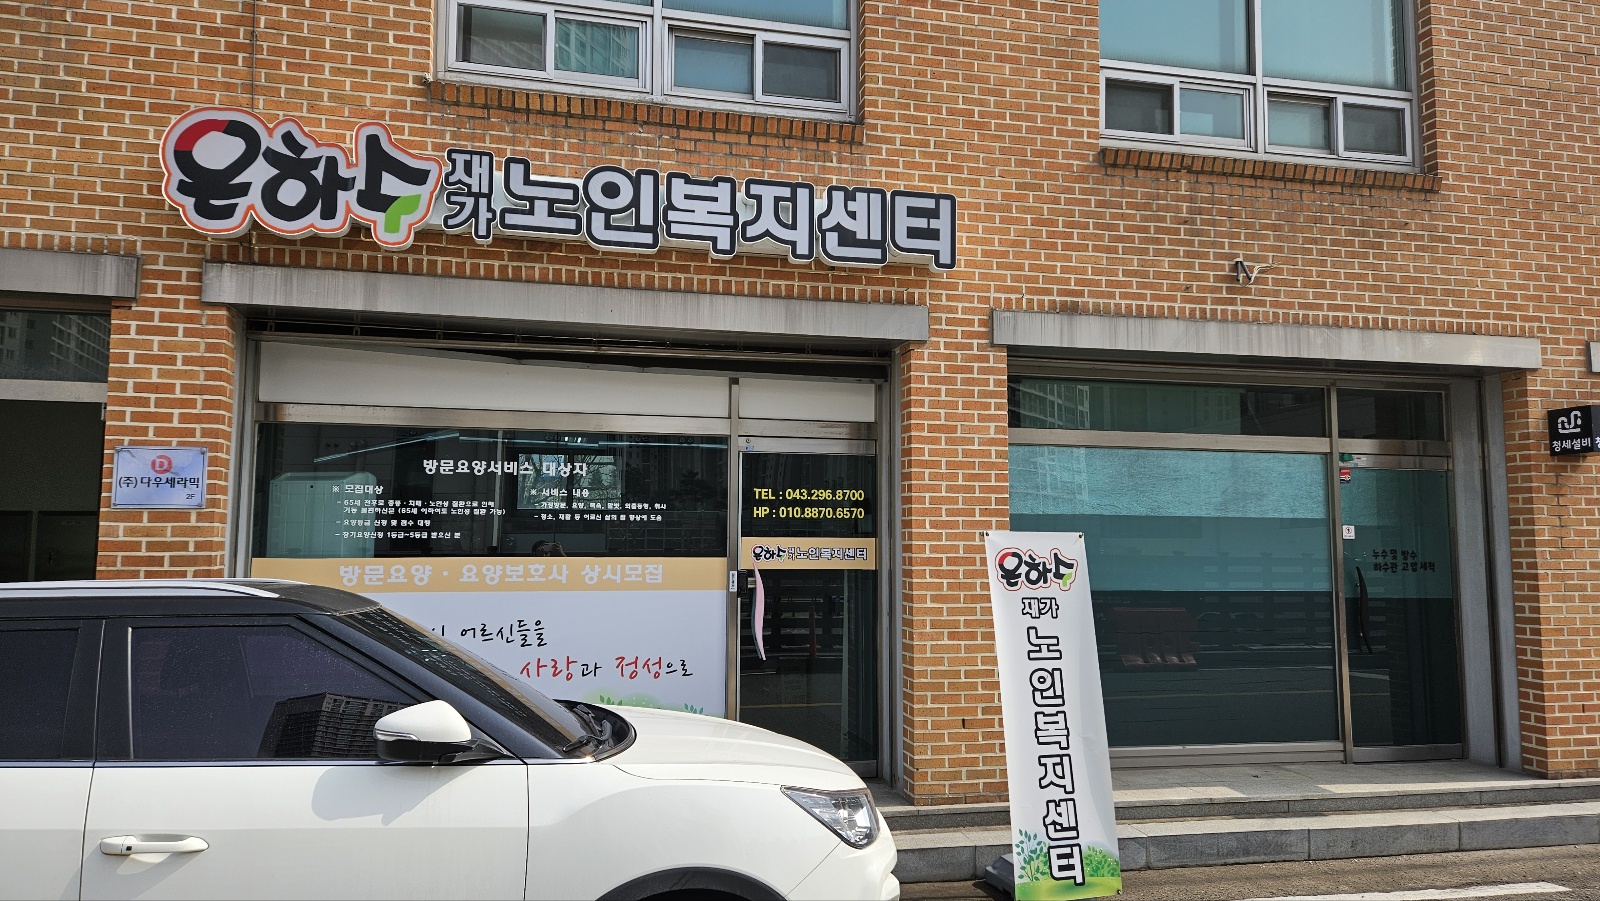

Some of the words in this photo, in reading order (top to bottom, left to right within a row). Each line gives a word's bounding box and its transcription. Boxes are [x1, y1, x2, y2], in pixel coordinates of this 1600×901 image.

[167, 112, 439, 243] 온하수
[502, 156, 957, 270] 노인복지센터
[1551, 437, 1591, 452] 청세설비
[423, 459, 534, 476] 방문요양서비스
[542, 461, 589, 477] 대상자
[140, 476, 200, 488] 다우세라믹
[344, 484, 384, 495] 모집대상
[541, 487, 568, 497] 서비스
[572, 488, 590, 498] 내용
[753, 487, 776, 500] TEL
[785, 488, 865, 501] 043.296.8700
[343, 499, 361, 507] 65세
[450, 508, 470, 516] 노인성
[753, 506, 770, 518] HP
[779, 506, 865, 519] 010.8870.6570
[796, 546, 868, 561] 노인복지센터
[1371, 548, 1389, 560] 누수
[1400, 549, 1418, 561] 방수
[339, 564, 433, 587] 방문요양
[459, 563, 569, 585] 요양보호사
[580, 563, 664, 585] 상시모집
[998, 551, 1077, 589] 온하수
[1373, 562, 1399, 573] 하수관
[1021, 597, 1059, 618] 재가
[460, 619, 548, 648] 어르신들을
[519, 656, 603, 682] 사랑과
[614, 655, 694, 681] 정성으로
[1026, 625, 1086, 886] 노인복지센터
